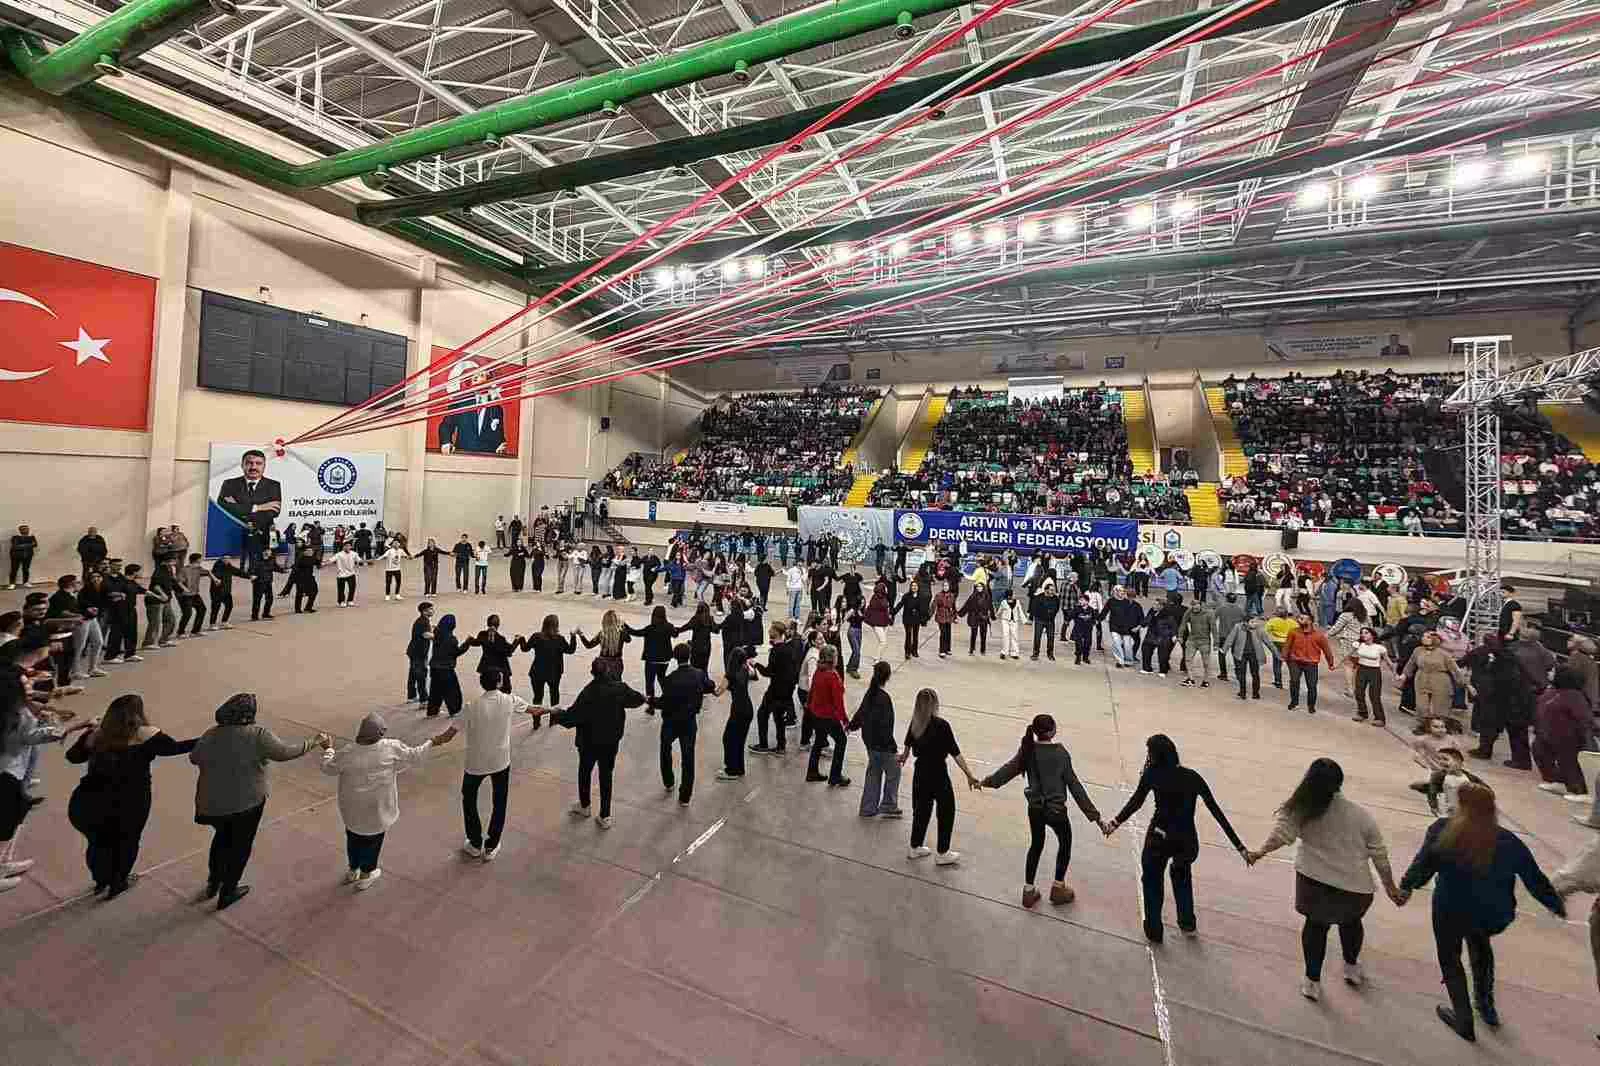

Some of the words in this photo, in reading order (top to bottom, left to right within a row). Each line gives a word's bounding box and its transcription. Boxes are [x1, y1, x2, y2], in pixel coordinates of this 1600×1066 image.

[293, 497, 313, 505] TÜM
[317, 498, 375, 506] SPORCULARA
[288, 510, 341, 519] BAŞARILAR
[1012, 520, 1027, 530] ve
[1033, 519, 1092, 534] KAFKAS
[1017, 534, 1129, 551] FEDERASYONU
